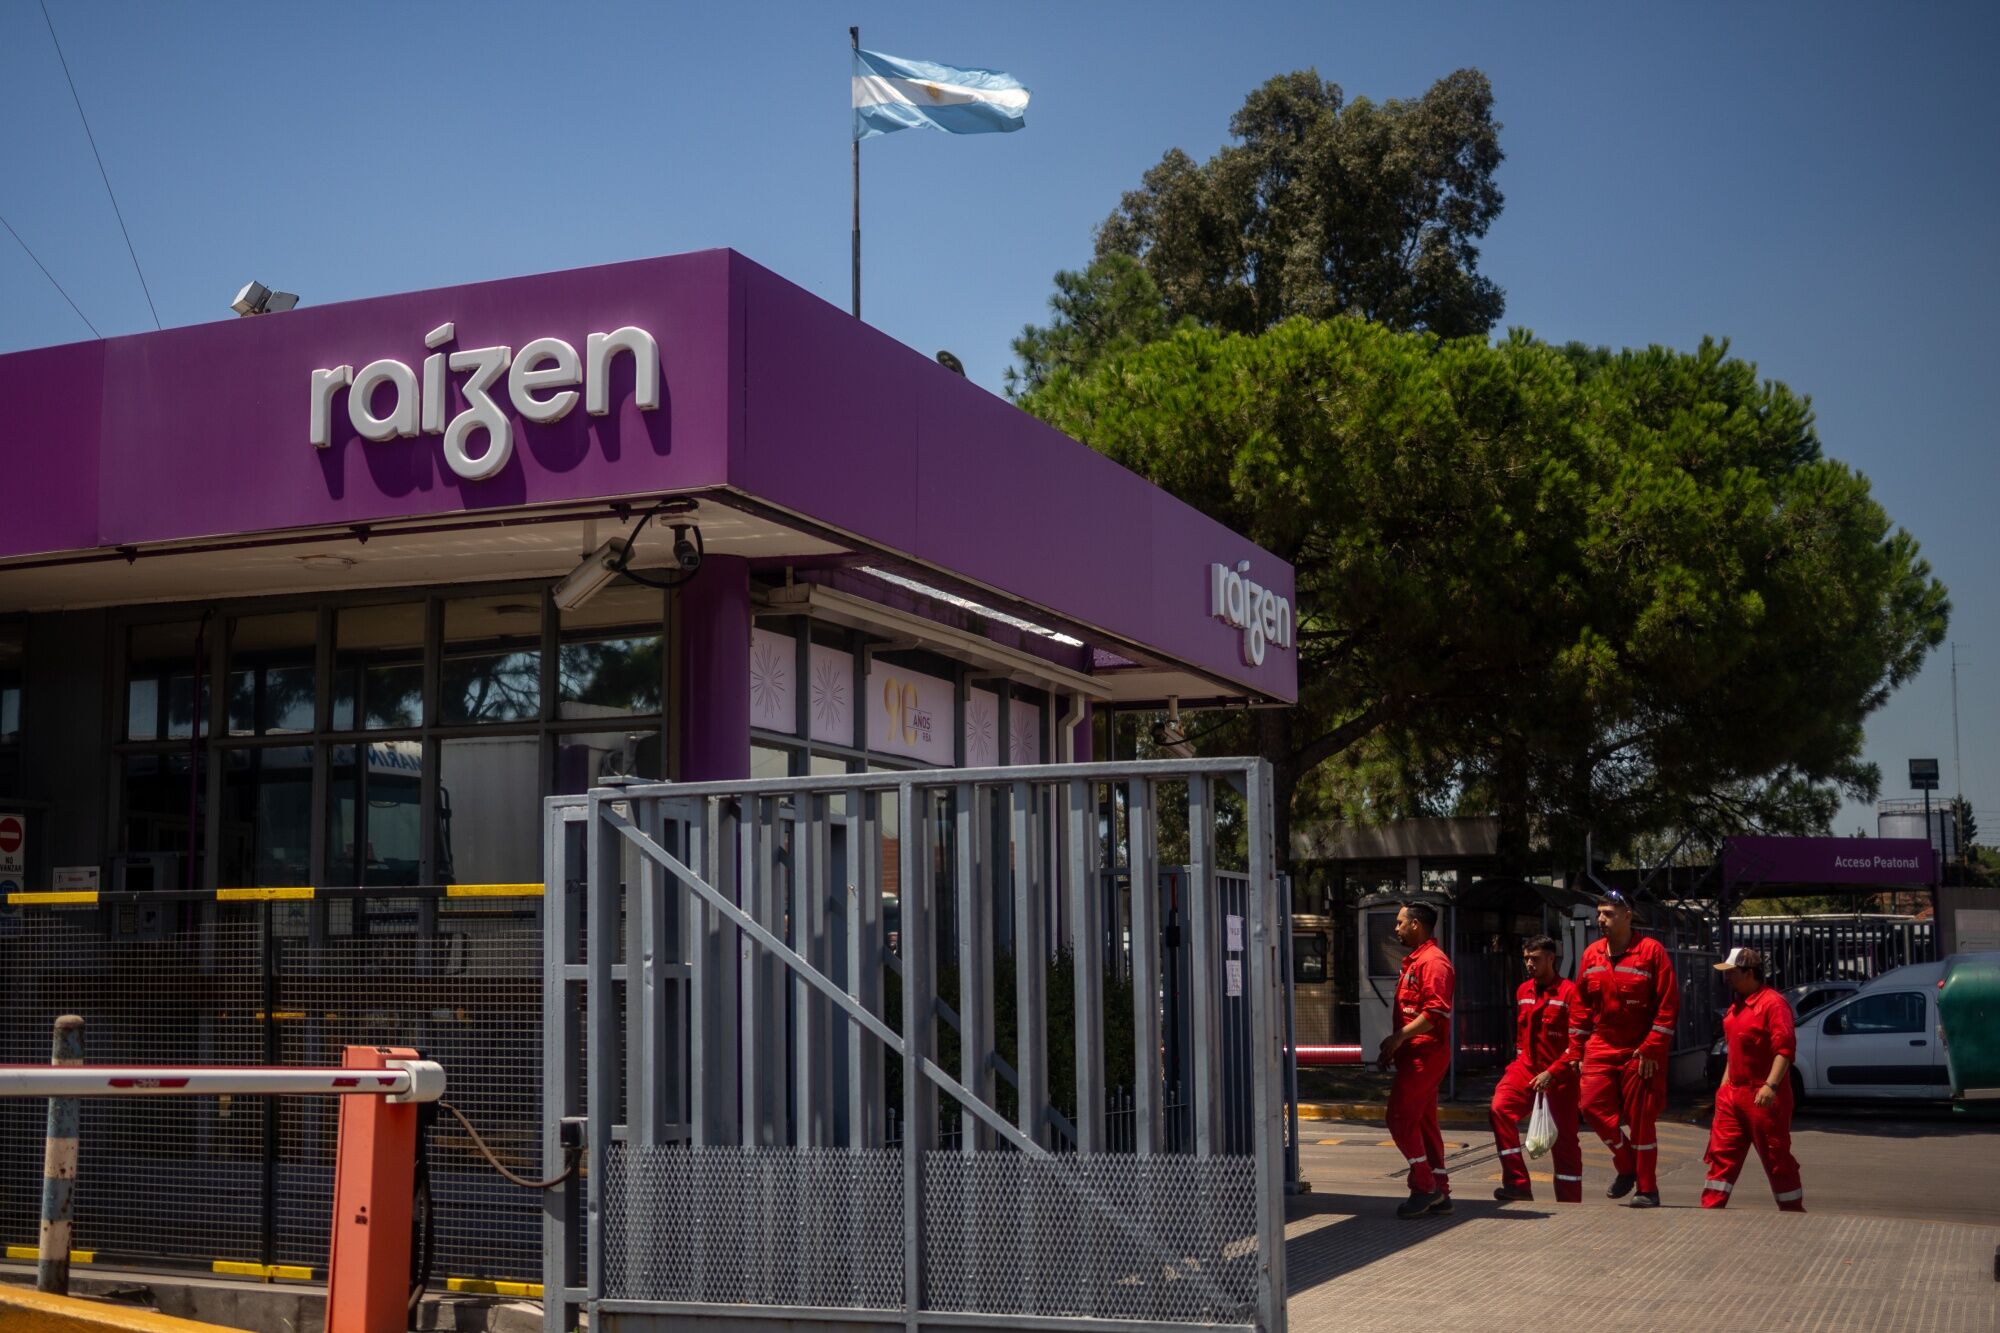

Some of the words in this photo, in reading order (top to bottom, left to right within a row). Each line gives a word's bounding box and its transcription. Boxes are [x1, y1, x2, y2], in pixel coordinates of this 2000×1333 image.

[884, 677, 918, 746] 90
[913, 711, 930, 730] AÑOS
[5, 856, 13, 864] NO
[1835, 856, 1871, 868] Acceso
[1873, 856, 1919, 868] Peatonal
[0, 864, 22, 872] VANZAR
